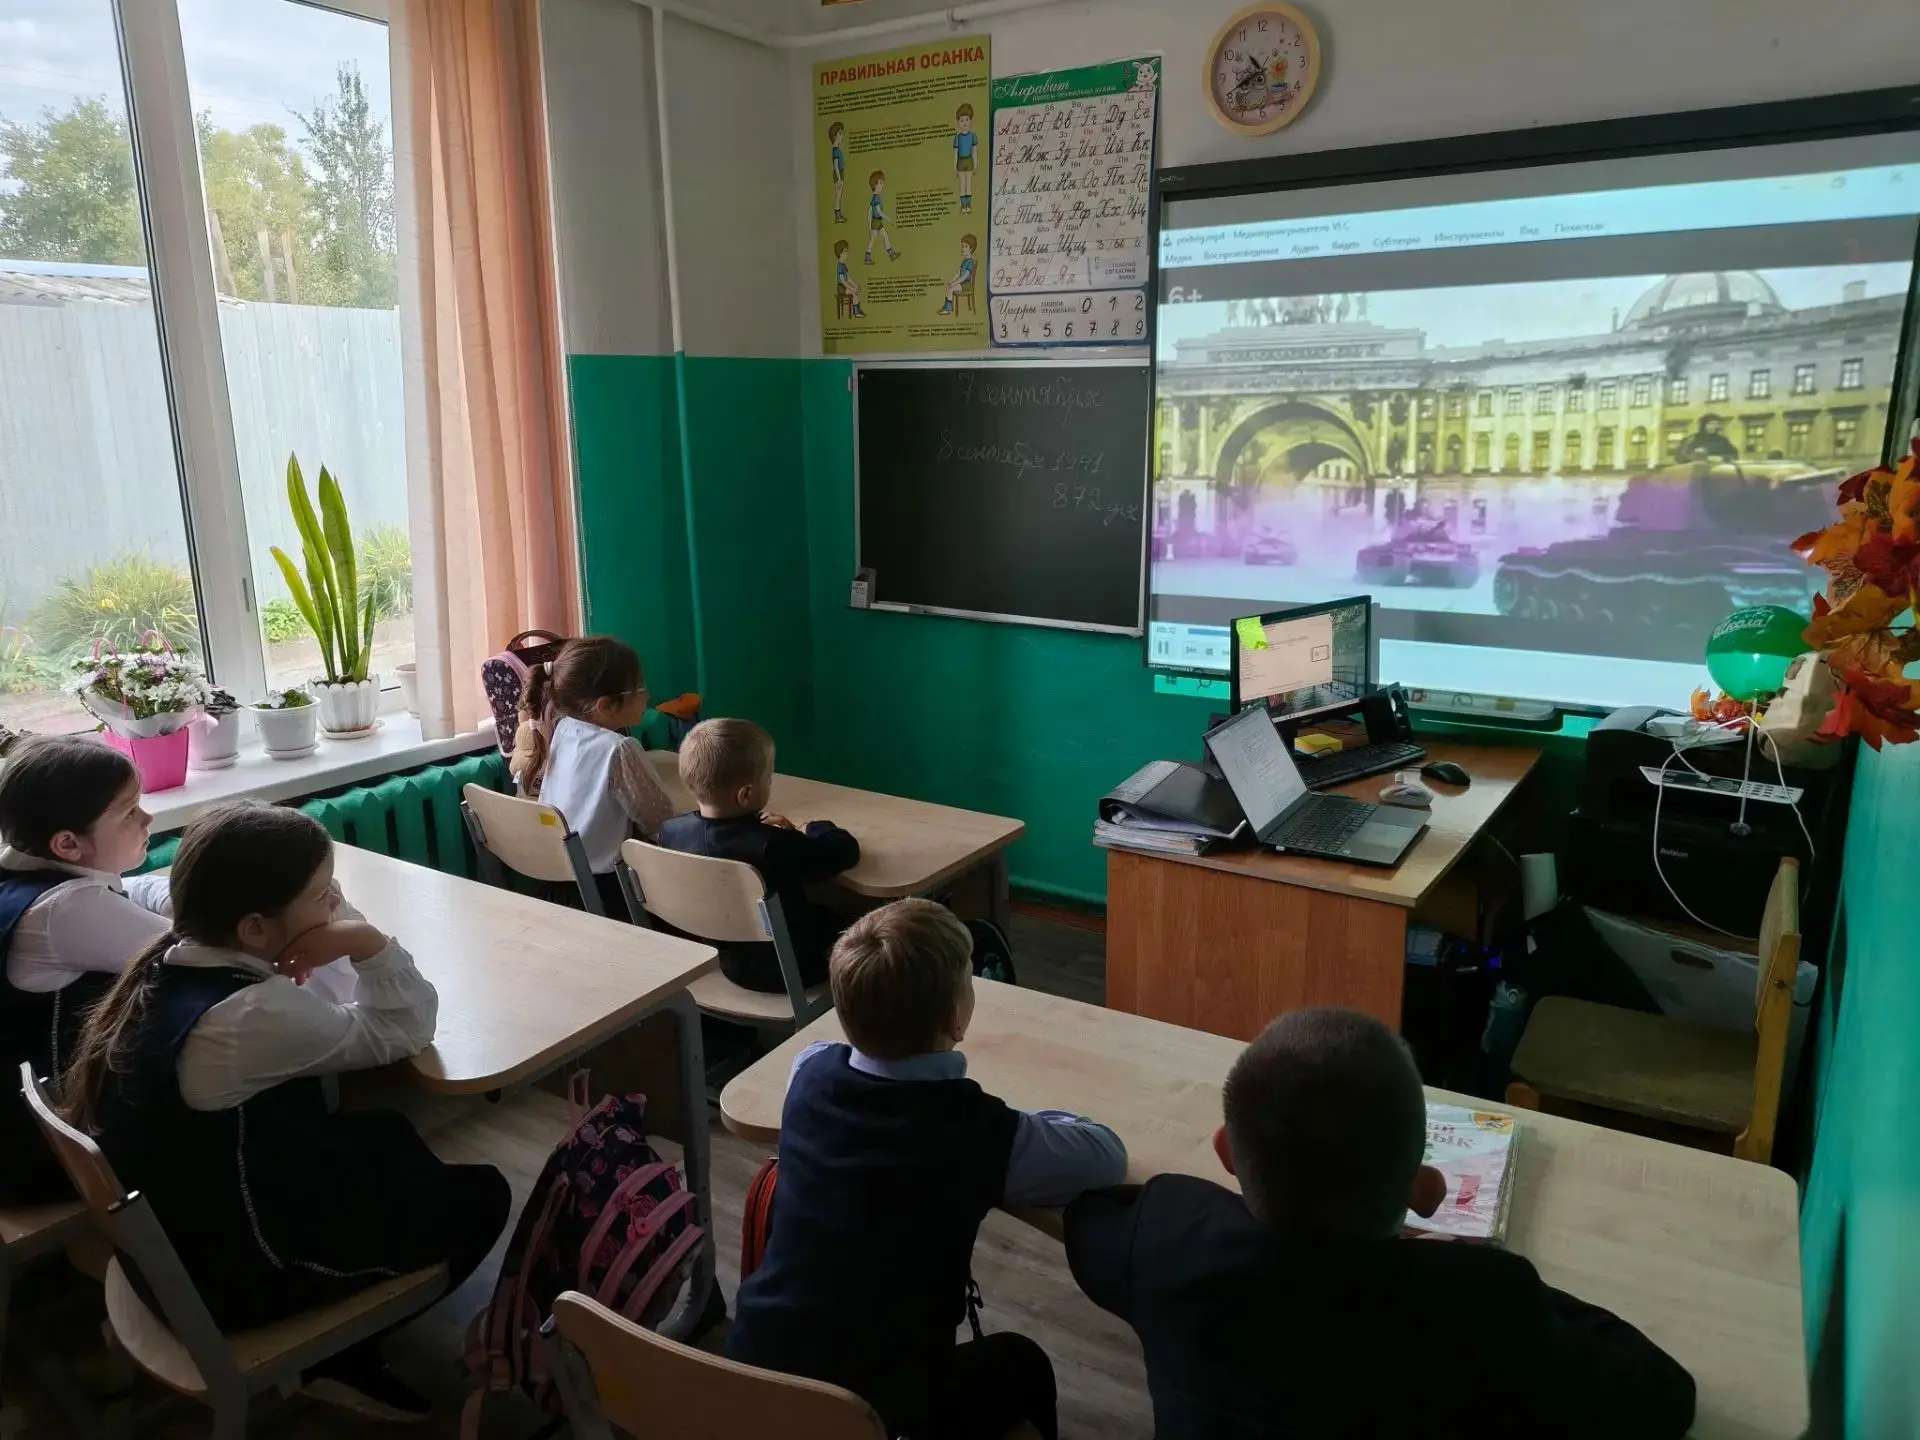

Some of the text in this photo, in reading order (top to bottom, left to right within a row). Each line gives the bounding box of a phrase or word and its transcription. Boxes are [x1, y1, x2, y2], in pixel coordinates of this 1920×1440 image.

[1257, 19, 1267, 32] 12
[1281, 21, 1284, 32] 1
[1240, 30, 1246, 42] 11
[1294, 34, 1301, 46] 2
[1224, 49, 1234, 62] 10
[1300, 56, 1306, 68] 3
[820, 46, 985, 86] ПРАВИЛЬНАЯ ОСАНКА
[1294, 80, 1301, 90] 4
[1226, 92, 1234, 104] 8
[998, 100, 1150, 136] Аа Бб Вв Гг Дд Ее
[1240, 106, 1247, 117] 7
[1260, 106, 1266, 118] 6
[996, 132, 1150, 166] Ёё Жж Зз Ии Йй Кк
[994, 177, 1016, 196] Лл
[1021, 175, 1051, 193] Мм
[1056, 172, 1077, 191] Нн
[1082, 170, 1099, 188] Оо
[1103, 165, 1125, 186] Пп
[1131, 164, 1148, 187] Рр
[994, 196, 1146, 228] Сс Тт Уу Фф Хх Цц
[996, 238, 1012, 256] Чч
[1021, 236, 1048, 256] Шш
[1056, 234, 1087, 256] Щщ
[994, 268, 1012, 287] Ээ
[1018, 266, 1046, 286] Юю
[1082, 295, 1144, 313] 0 1 2
[1168, 286, 1204, 304] 6+
[1000, 300, 1036, 323] Цифры
[1000, 325, 1008, 338] 3
[1022, 325, 1030, 338] 4
[1043, 324, 1051, 338] 5
[1064, 322, 1072, 336] 6
[1089, 322, 1097, 336] 7
[1111, 322, 1120, 336] 8
[1135, 320, 1144, 334] 9
